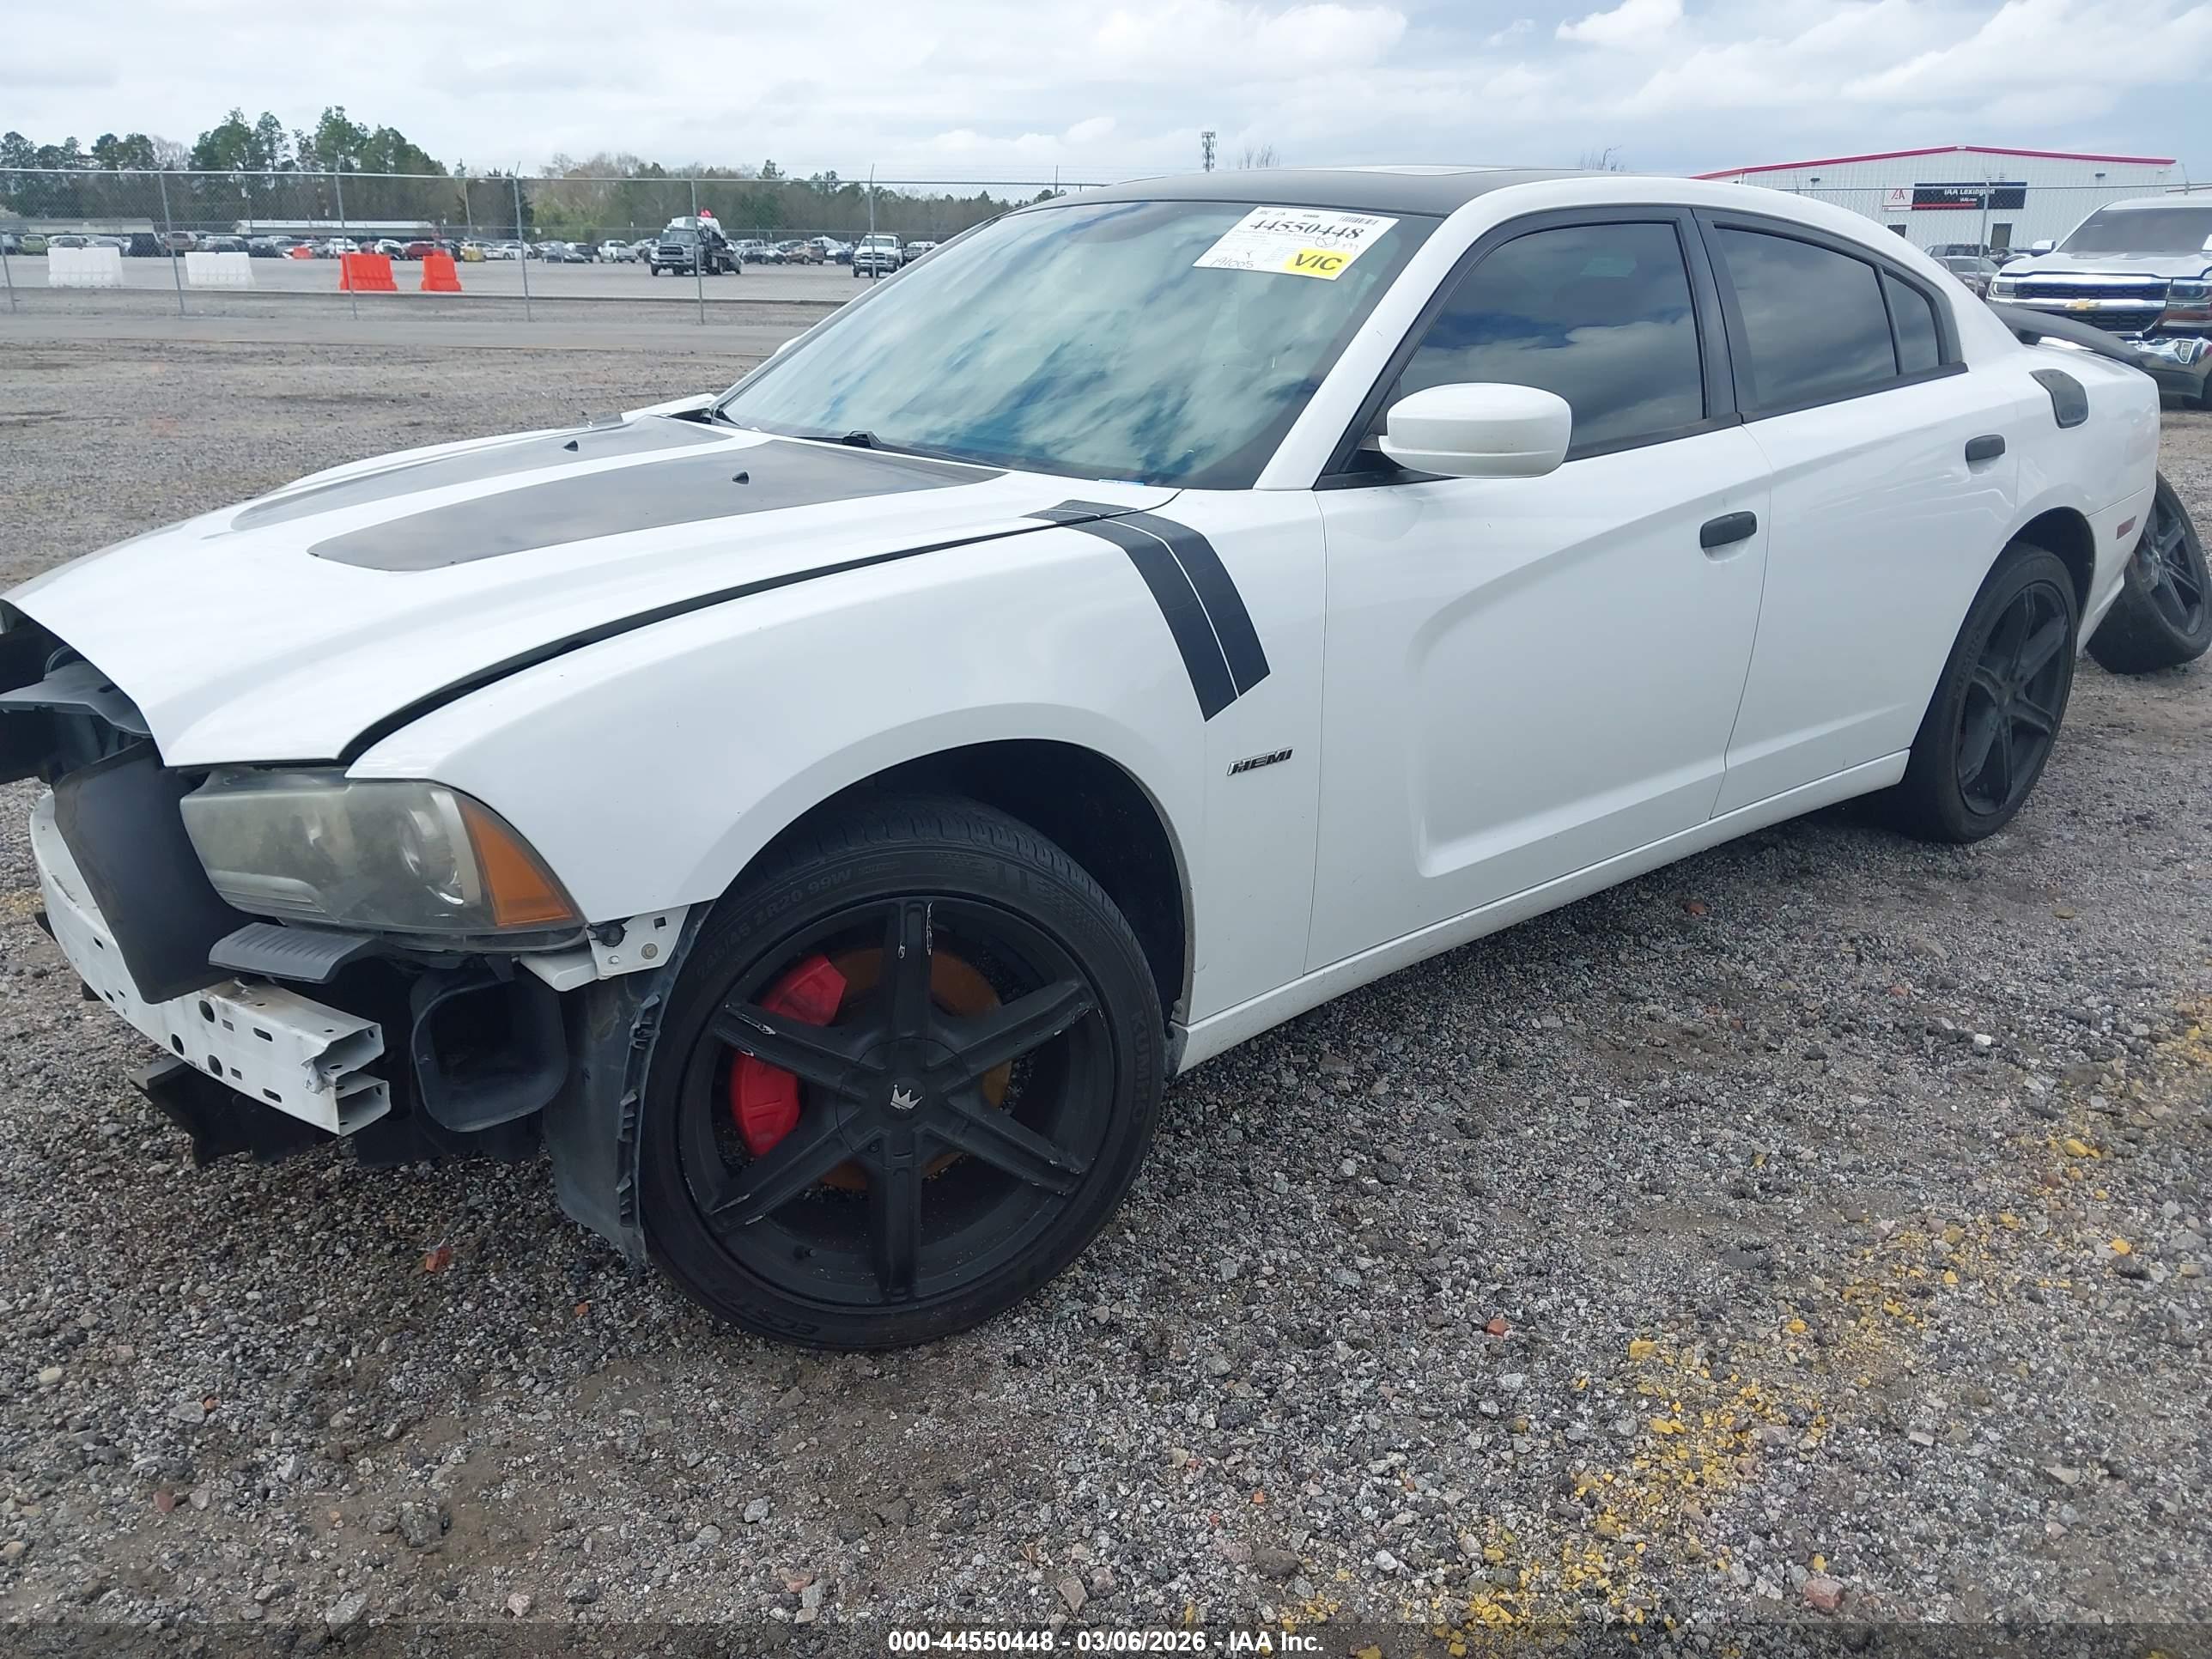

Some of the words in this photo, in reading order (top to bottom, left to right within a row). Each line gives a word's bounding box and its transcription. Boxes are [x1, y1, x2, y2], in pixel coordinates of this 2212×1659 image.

[1249, 218, 1364, 240] 44550448
[1294, 252, 1343, 270] VIC
[1227, 747, 1293, 776] HEMI
[807, 869, 852, 894] 99W
[1130, 1009, 1150, 1124] KUMHO
